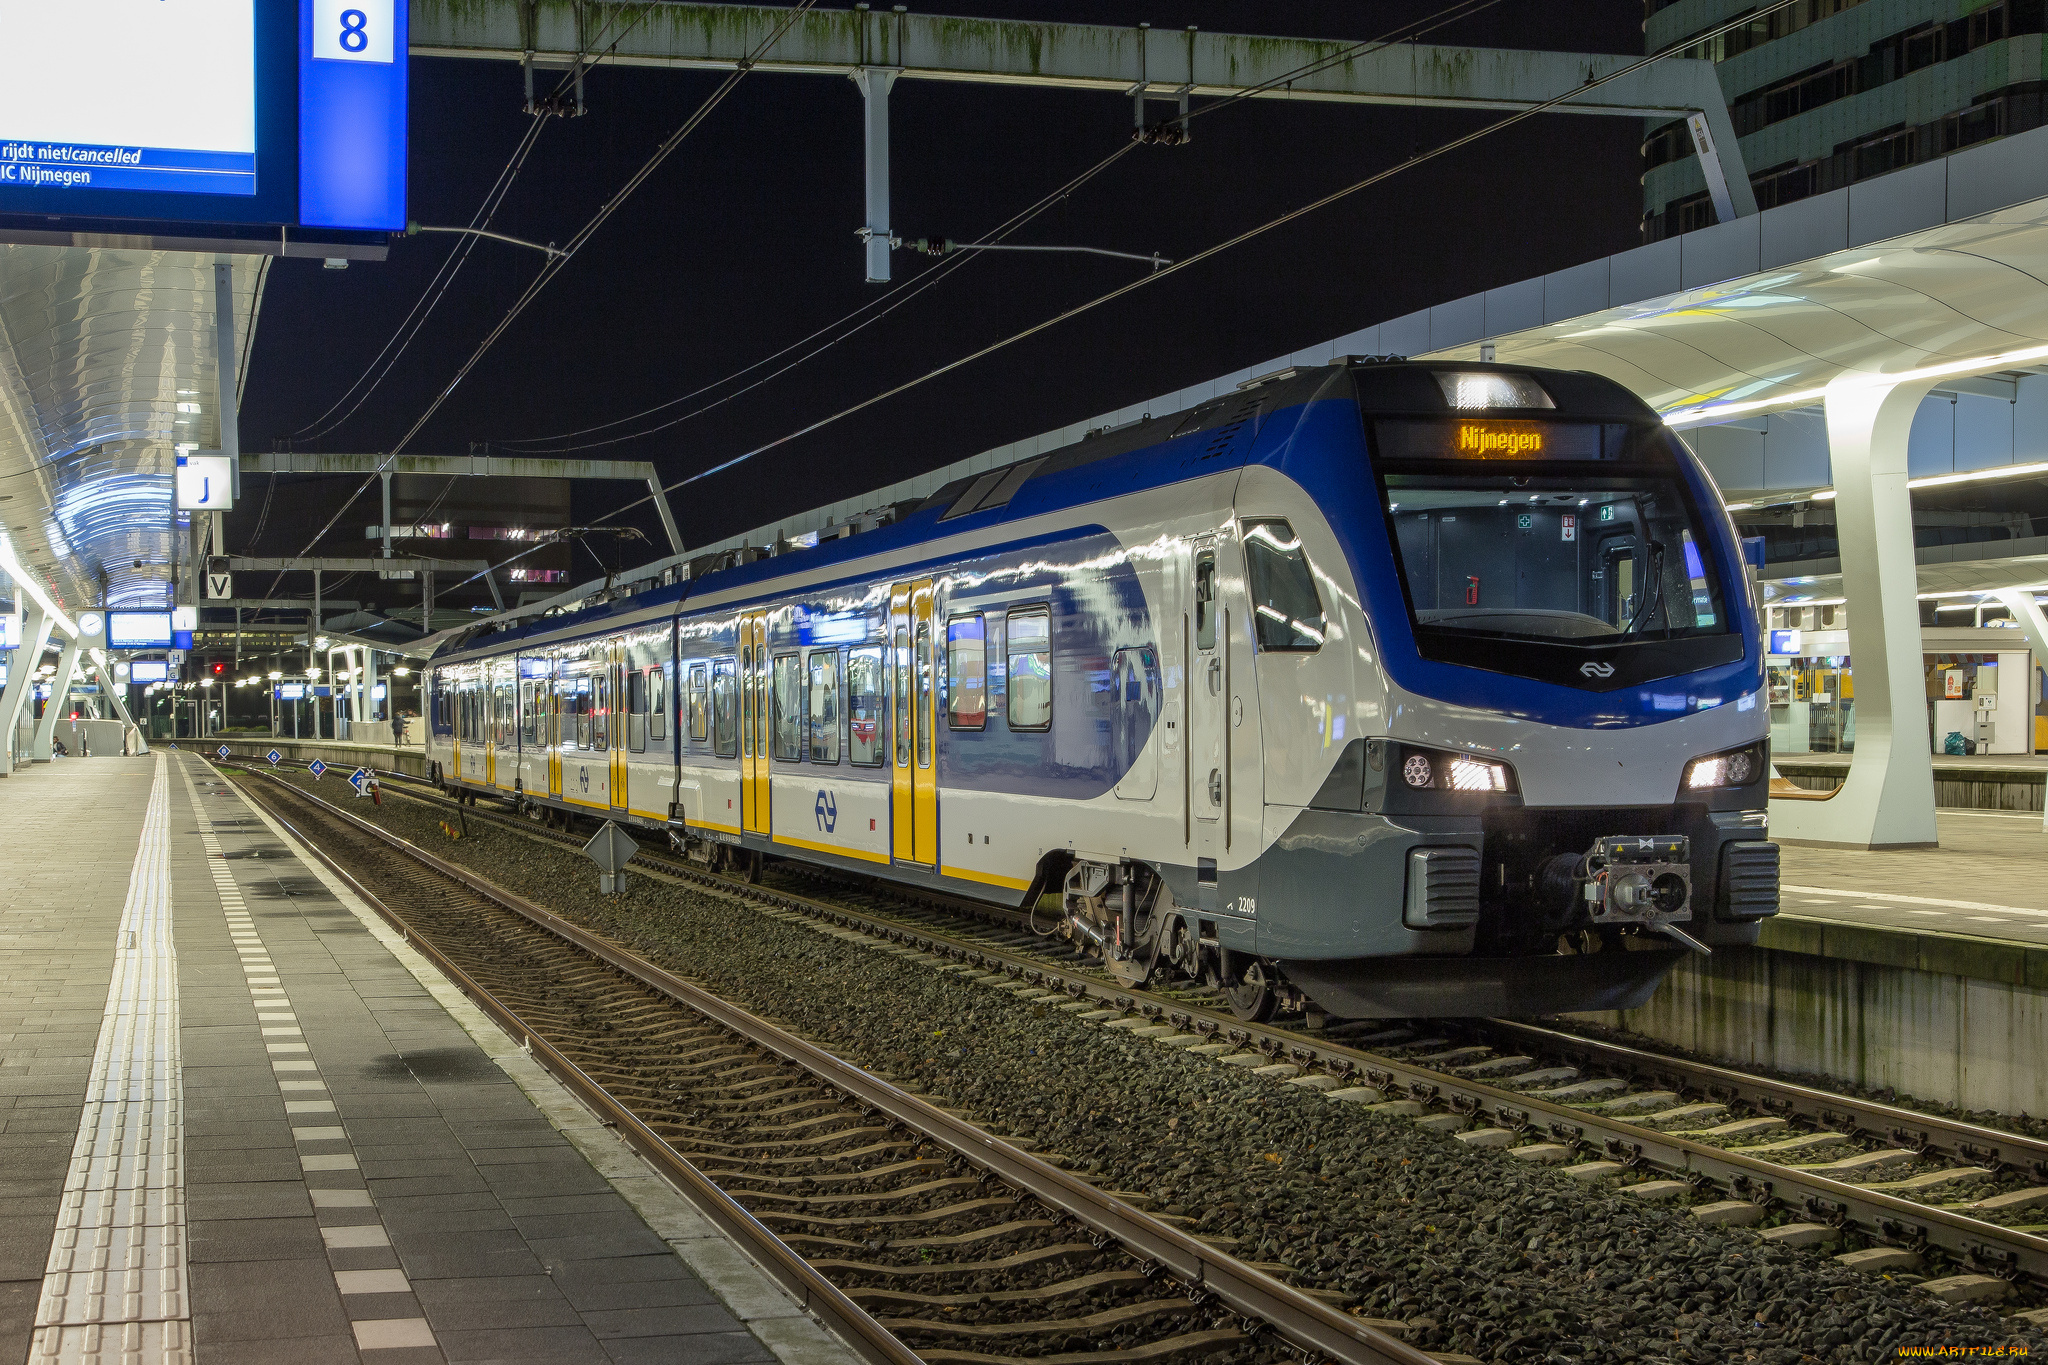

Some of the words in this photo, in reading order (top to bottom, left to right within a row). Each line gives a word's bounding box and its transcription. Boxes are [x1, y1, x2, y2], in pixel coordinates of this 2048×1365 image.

[339, 9, 369, 53] 8
[2, 143, 35, 162] rijdt
[38, 145, 142, 164] niet/cancelled
[1, 165, 16, 180] IC
[20, 166, 91, 186] Nijmegen
[1461, 427, 1541, 454] Nijmegen
[198, 477, 210, 504] J
[210, 576, 229, 597] V
[173, 654, 180, 662] H
[313, 763, 320, 771] 4
[1238, 896, 1256, 914] 2209
